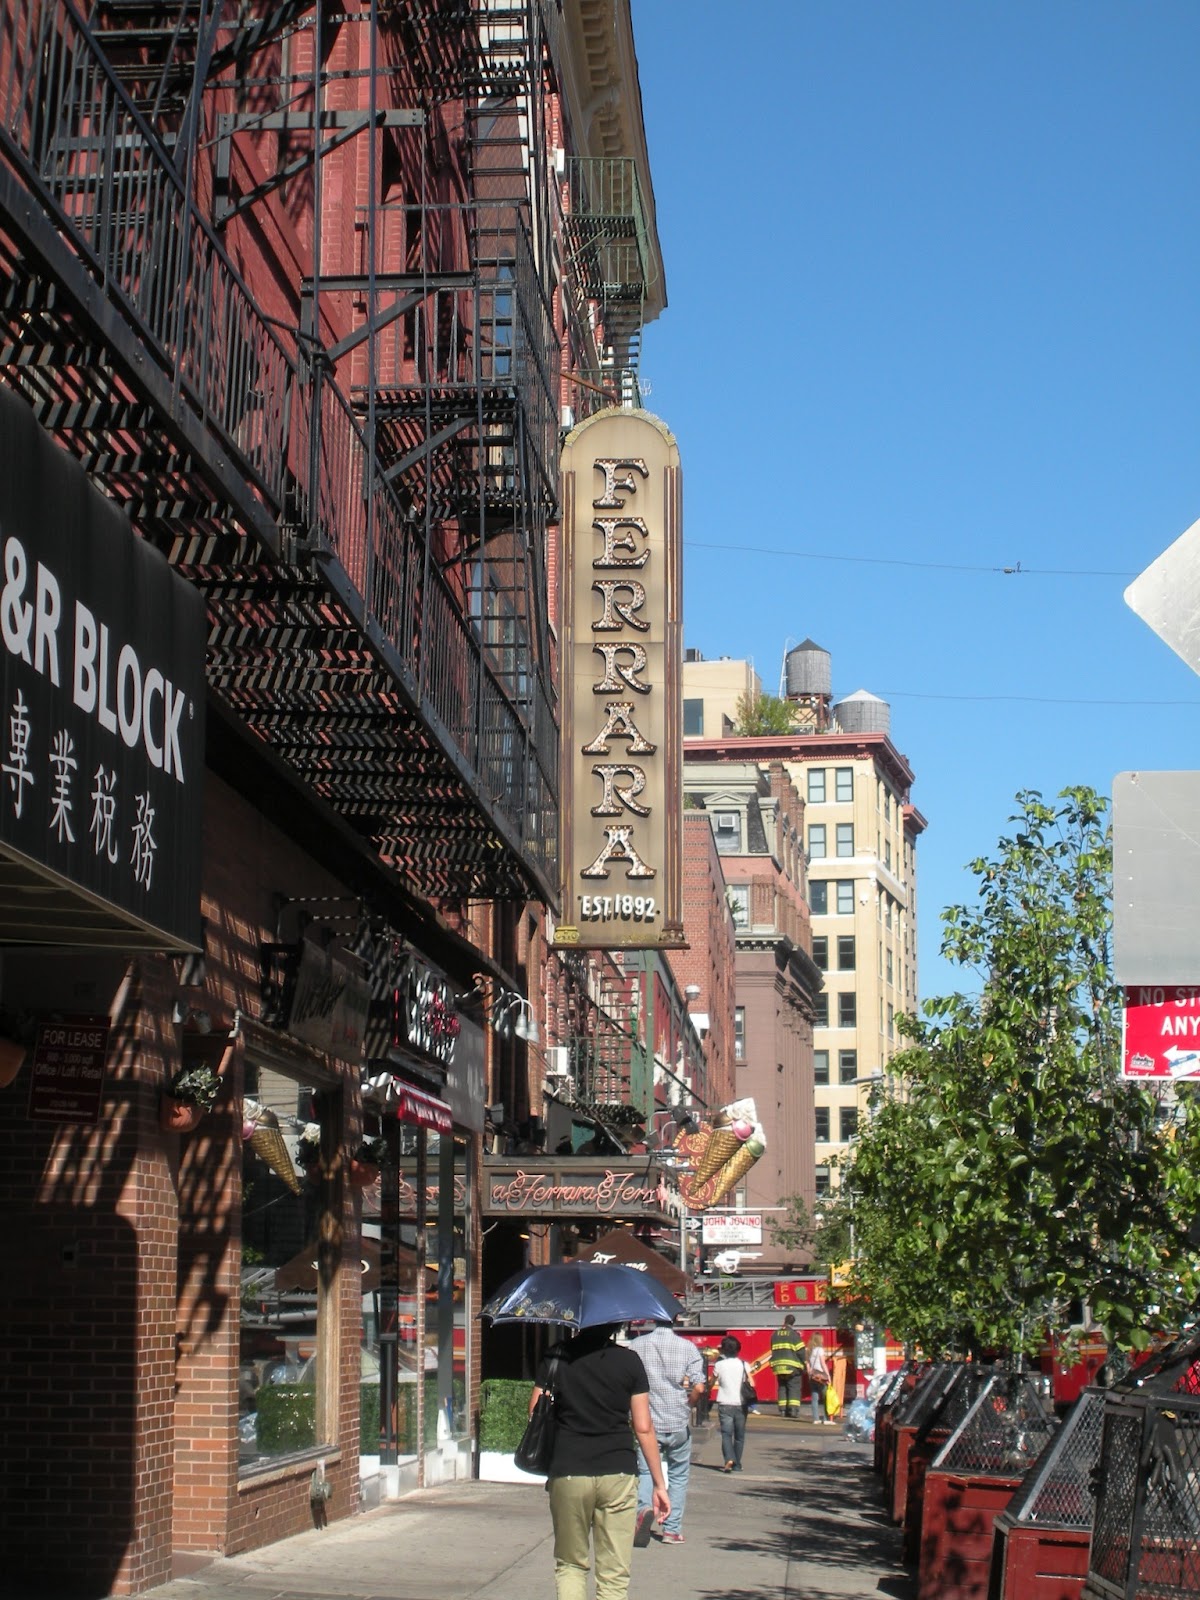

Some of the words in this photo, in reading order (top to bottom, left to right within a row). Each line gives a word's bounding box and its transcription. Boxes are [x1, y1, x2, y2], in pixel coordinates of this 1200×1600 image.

[581, 458, 657, 879] FERRARA
[73, 599, 186, 784] BLOCK
[613, 893, 656, 919] 1892
[1139, 987, 1165, 1007] NO
[1175, 986, 1200, 1007] ST
[43, 1030, 66, 1045] FOR
[67, 1031, 102, 1048] LEASE
[35, 1063, 57, 1076] Office
[80, 1066, 102, 1079] Retail
[703, 1216, 726, 1227] JOHN
[729, 1216, 761, 1227] JOVINO
